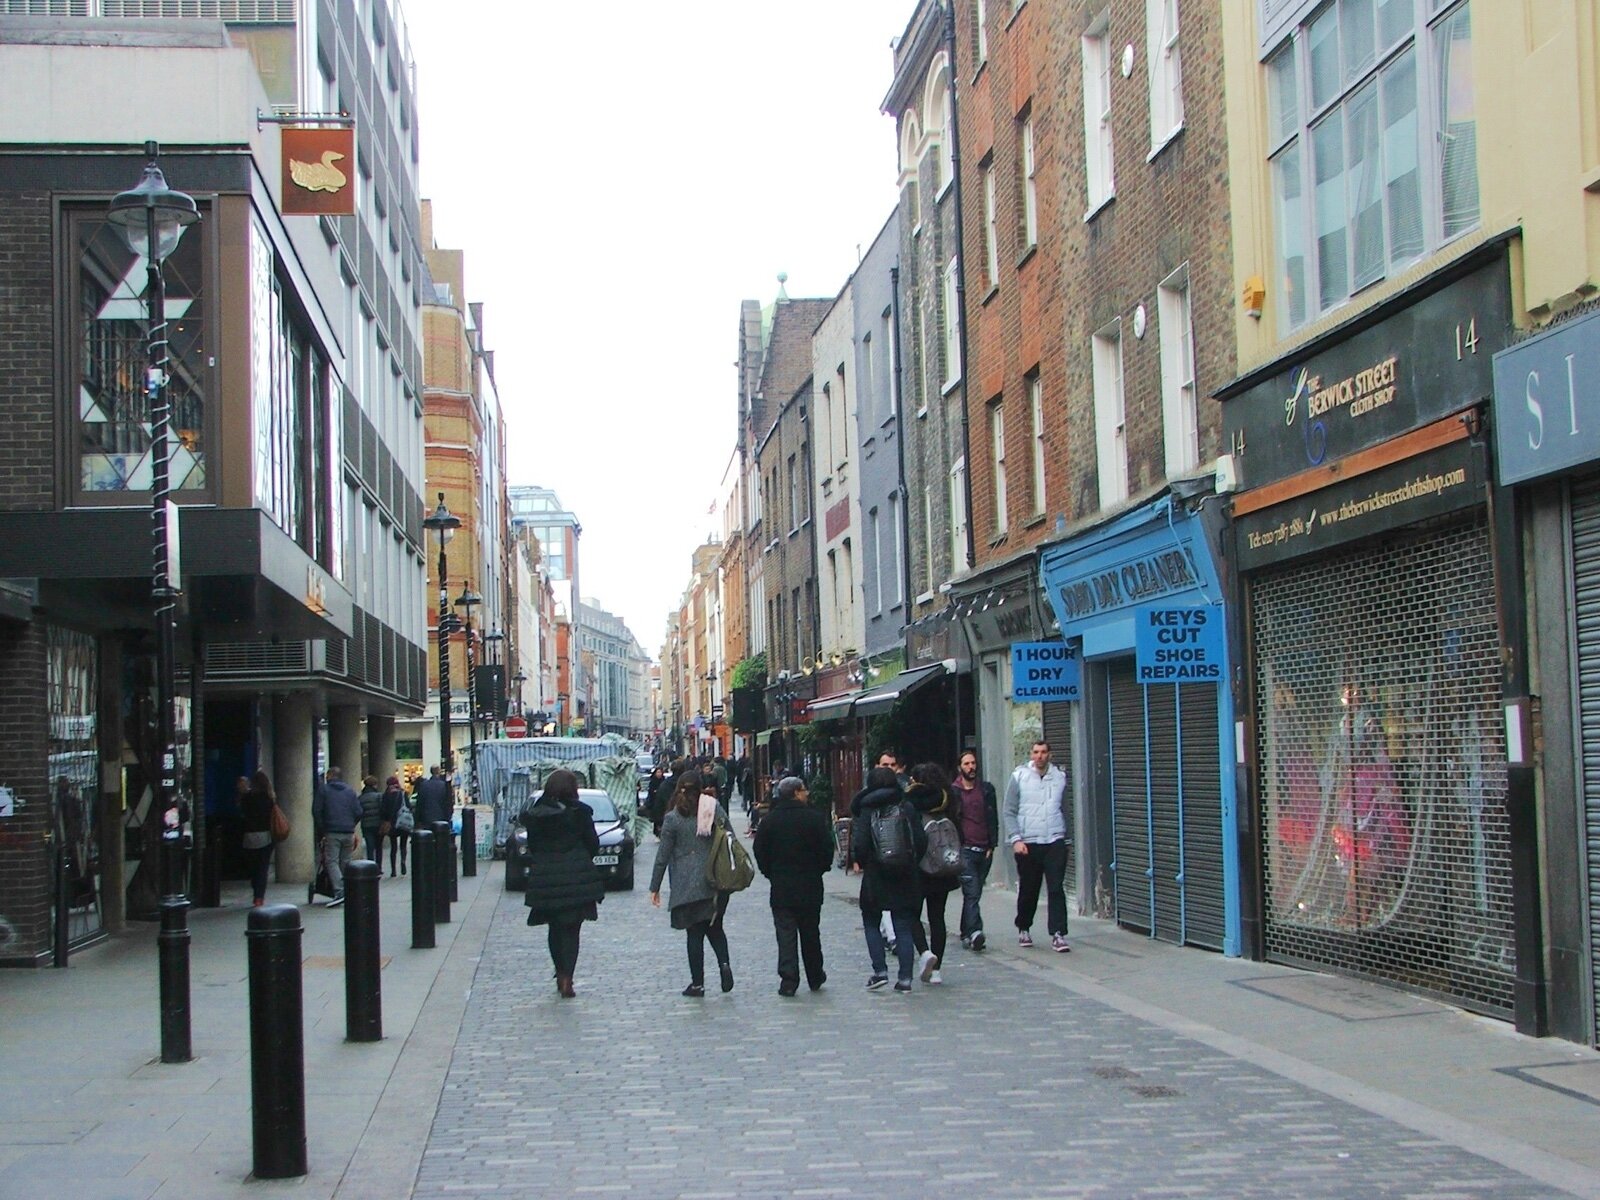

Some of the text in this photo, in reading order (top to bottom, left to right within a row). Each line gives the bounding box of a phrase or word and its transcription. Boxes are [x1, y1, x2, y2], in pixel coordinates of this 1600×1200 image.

[1455, 318, 1480, 361] 14
[1308, 356, 1396, 419] BERWICK STREET
[1350, 385, 1395, 418] CLOTH SHOP
[1526, 353, 1579, 450] SI
[1231, 429, 1246, 459] 14
[1320, 467, 1465, 526] www.theberwickstreetclothshop.com
[1091, 569, 1123, 608] DRY
[1150, 610, 1207, 626] KEYS
[1157, 627, 1201, 644] CUT
[1015, 647, 1075, 661] 1 HOUR
[1154, 648, 1206, 663] SHOE
[1028, 668, 1063, 681] DRY
[1140, 664, 1220, 679] REPAIRS
[1015, 686, 1078, 696] CLEANING
